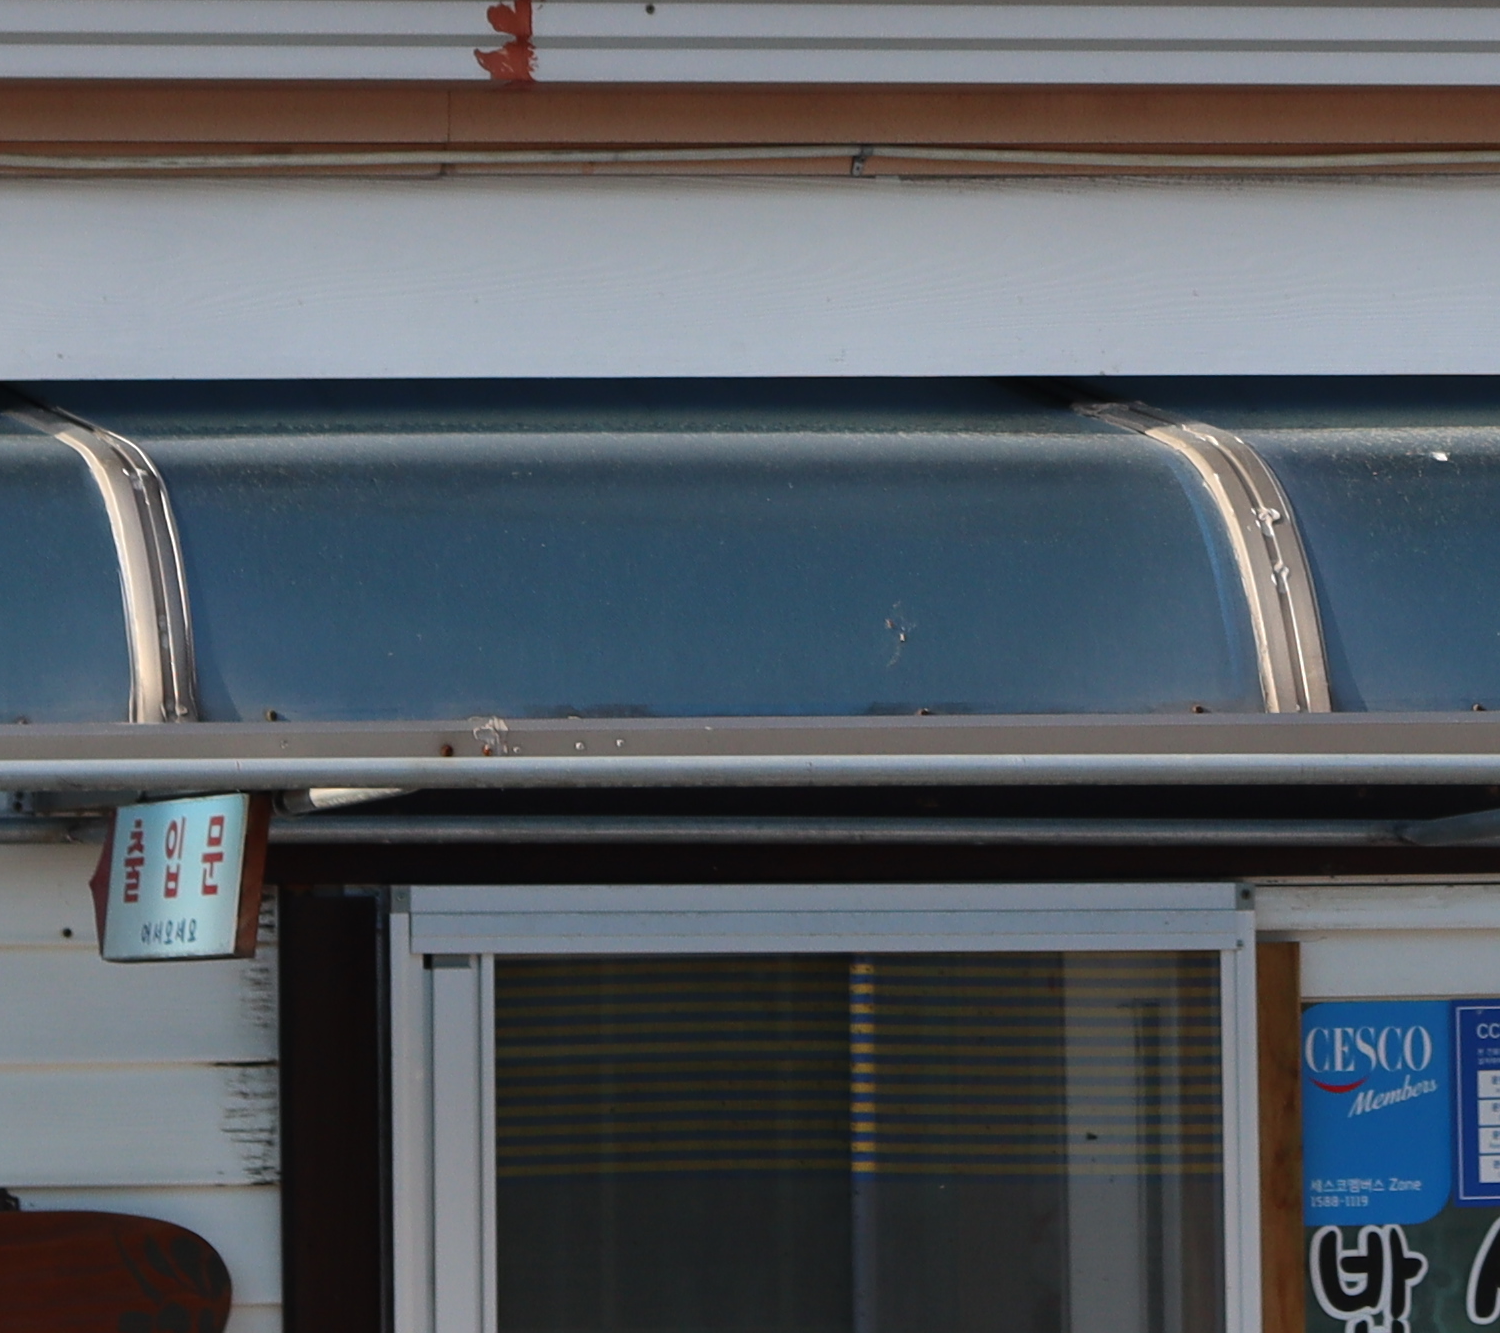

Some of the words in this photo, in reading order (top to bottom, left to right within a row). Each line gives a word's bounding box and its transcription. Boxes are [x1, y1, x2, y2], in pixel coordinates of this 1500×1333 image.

[123, 814, 225, 904] 출입문
[1304, 1024, 1433, 1073] CESCO
[1346, 1073, 1439, 1118] Members
[1310, 1178, 1386, 1193] 세스코멤버스
[1388, 1177, 1423, 1192] Zone
[1310, 1195, 1370, 1208] 1588-1119
